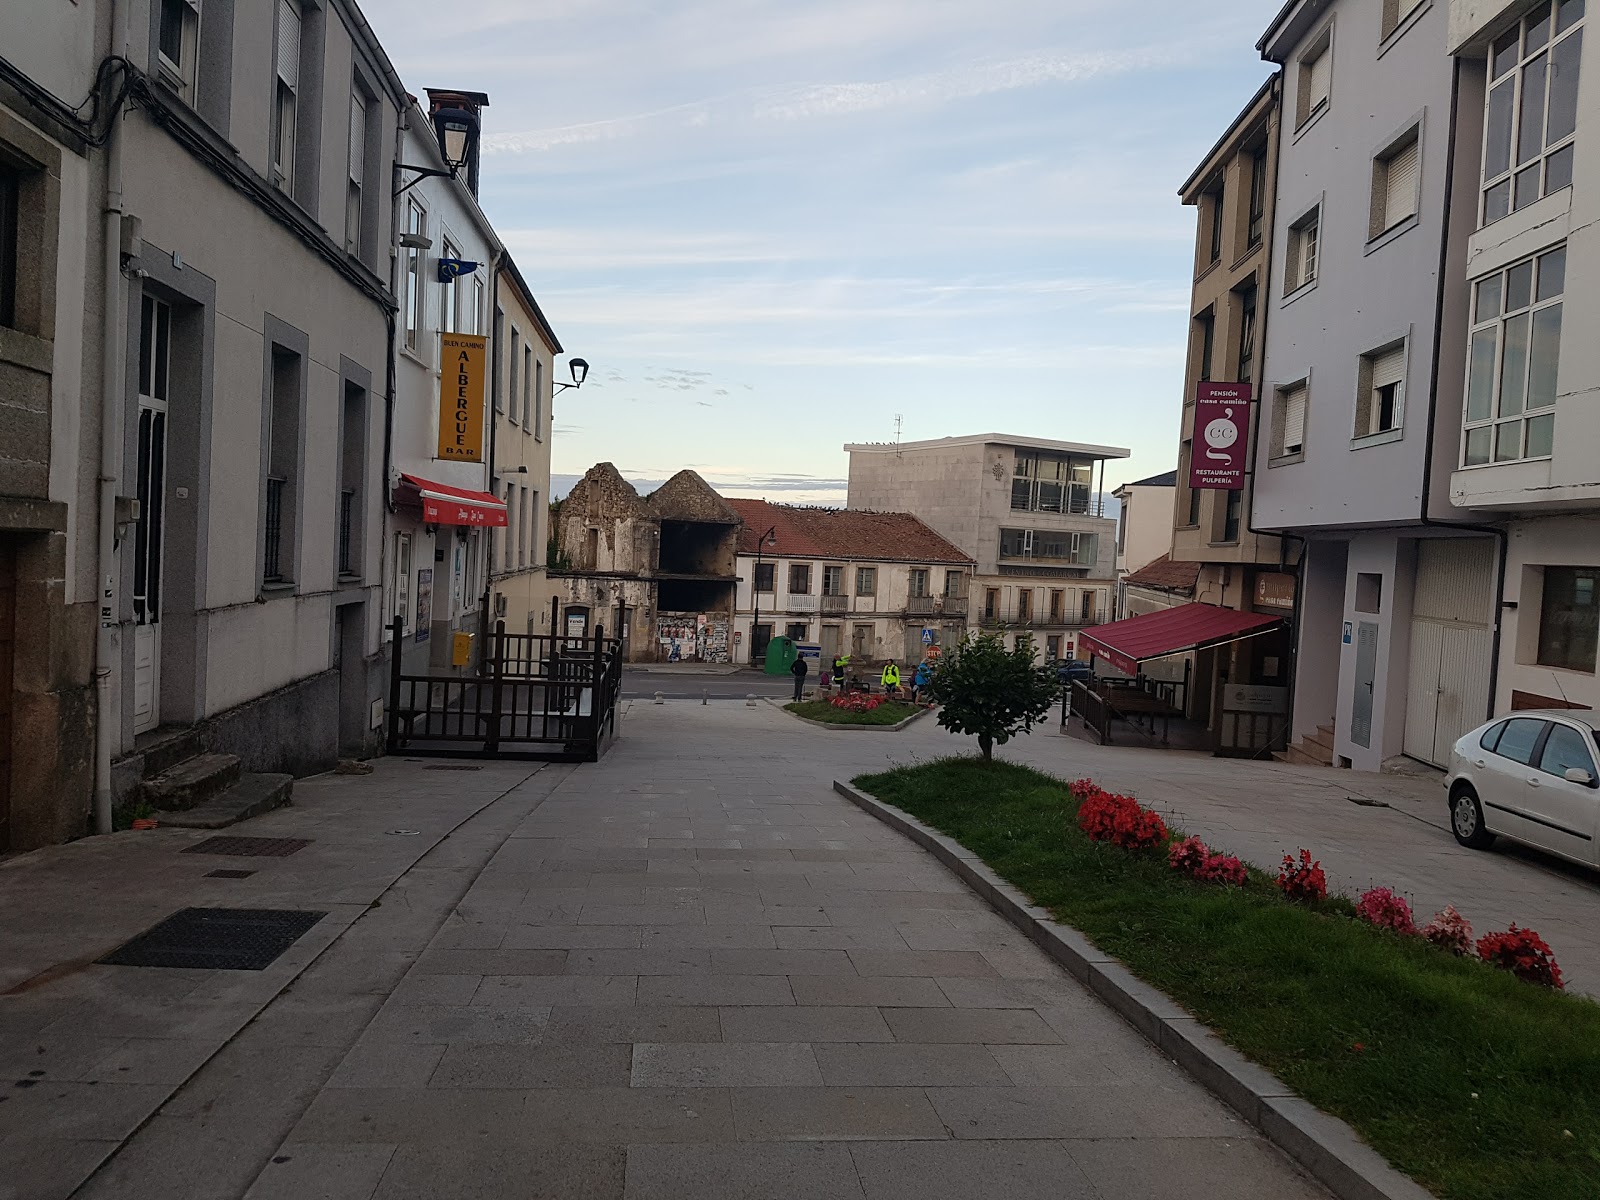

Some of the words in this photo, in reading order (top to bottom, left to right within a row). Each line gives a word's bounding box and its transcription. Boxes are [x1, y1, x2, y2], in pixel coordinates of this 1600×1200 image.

[443, 339, 459, 347] BUEN
[460, 341, 484, 350] CAMINO
[455, 350, 470, 445] ALBERGUE
[446, 447, 474, 456] BAR
